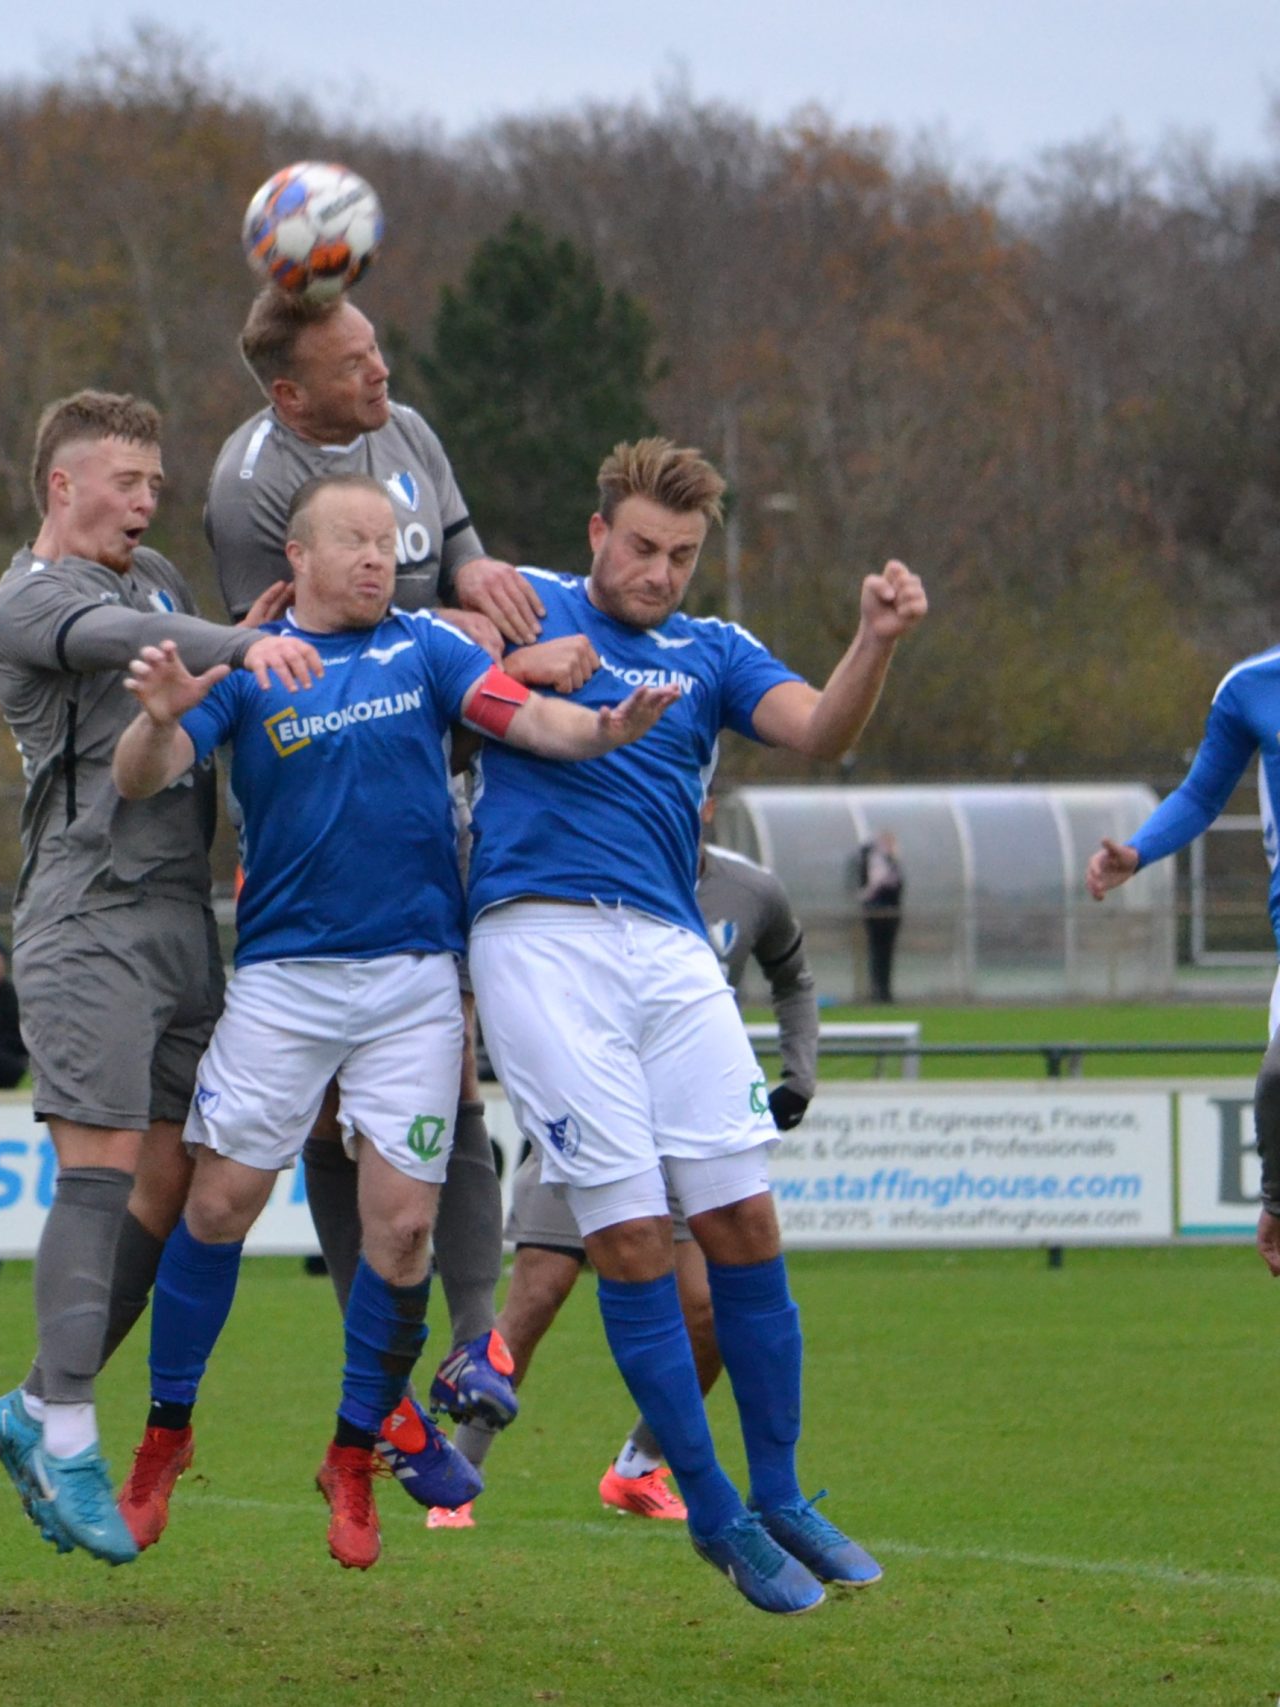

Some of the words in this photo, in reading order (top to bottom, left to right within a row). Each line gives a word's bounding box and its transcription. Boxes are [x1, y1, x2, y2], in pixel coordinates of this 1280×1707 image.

[277, 689, 421, 743] EUROKOZIJN
[971, 1136, 1117, 1159] Professionals
[770, 1167, 1143, 1208] w.staffinghouse.com
